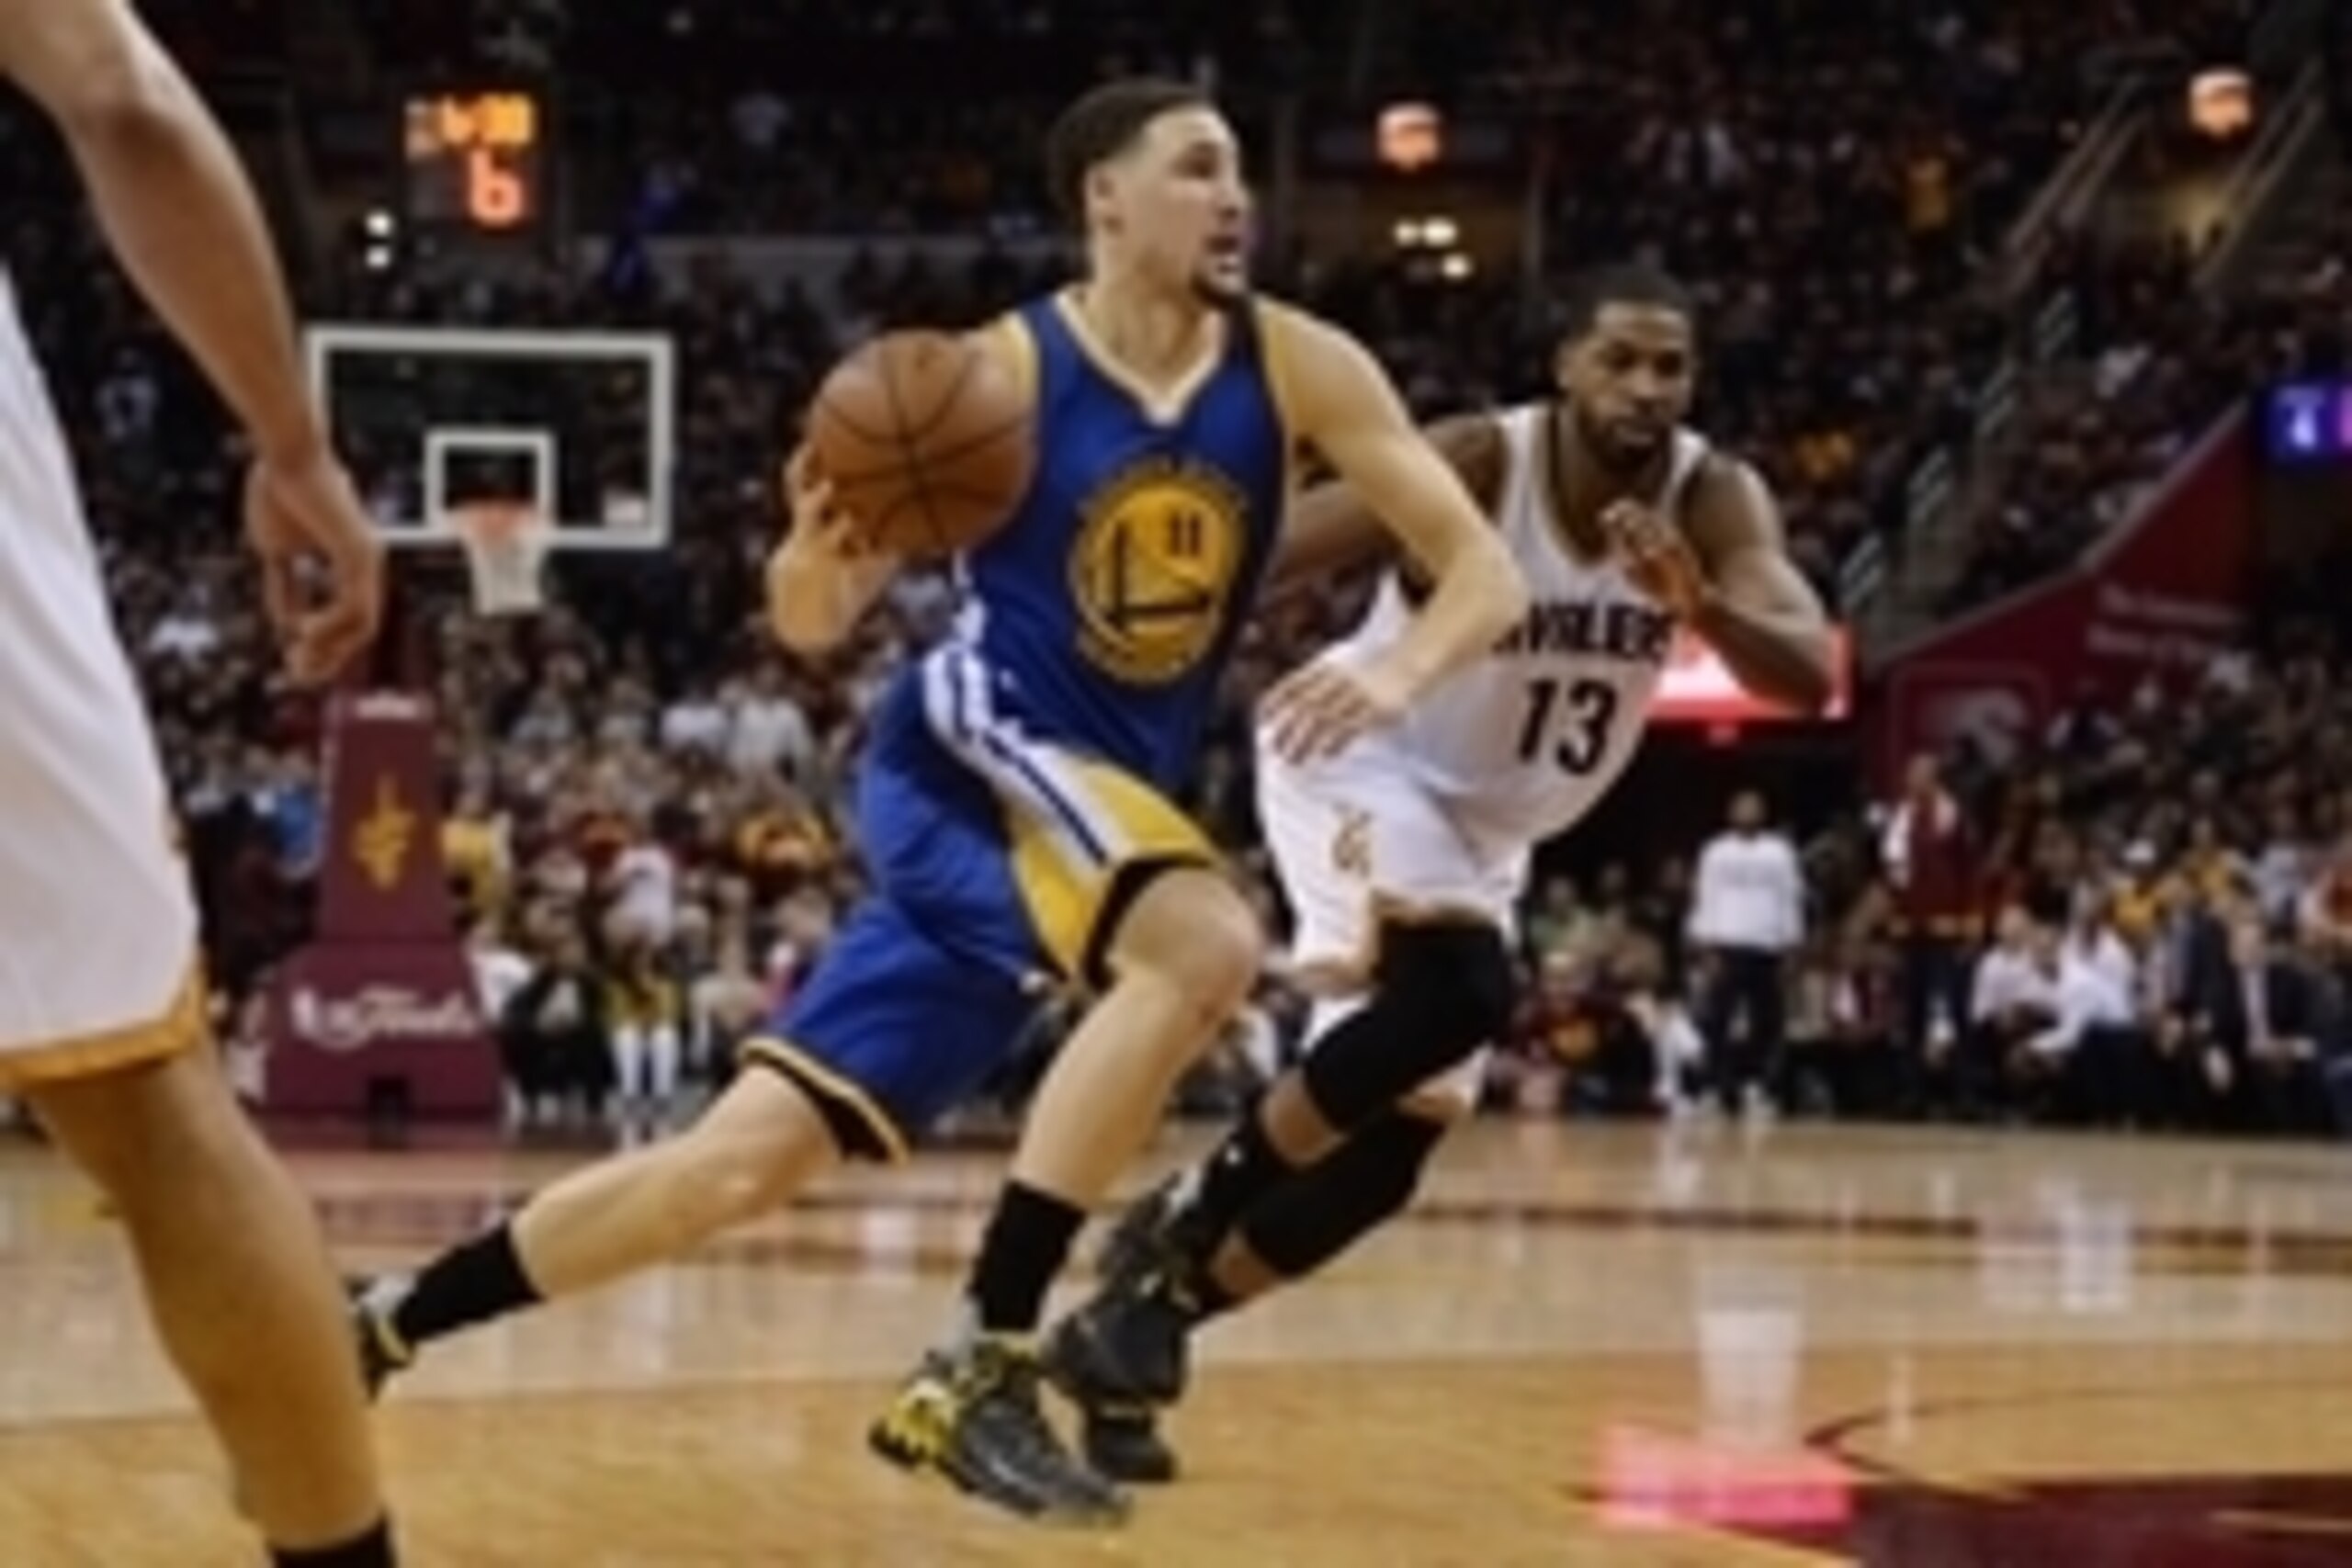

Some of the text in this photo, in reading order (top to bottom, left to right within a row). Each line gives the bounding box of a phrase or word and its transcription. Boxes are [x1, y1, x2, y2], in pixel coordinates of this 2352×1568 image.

[470, 151, 524, 226] 6
[1169, 510, 1202, 558] 11
[1517, 677, 1618, 776] 13
